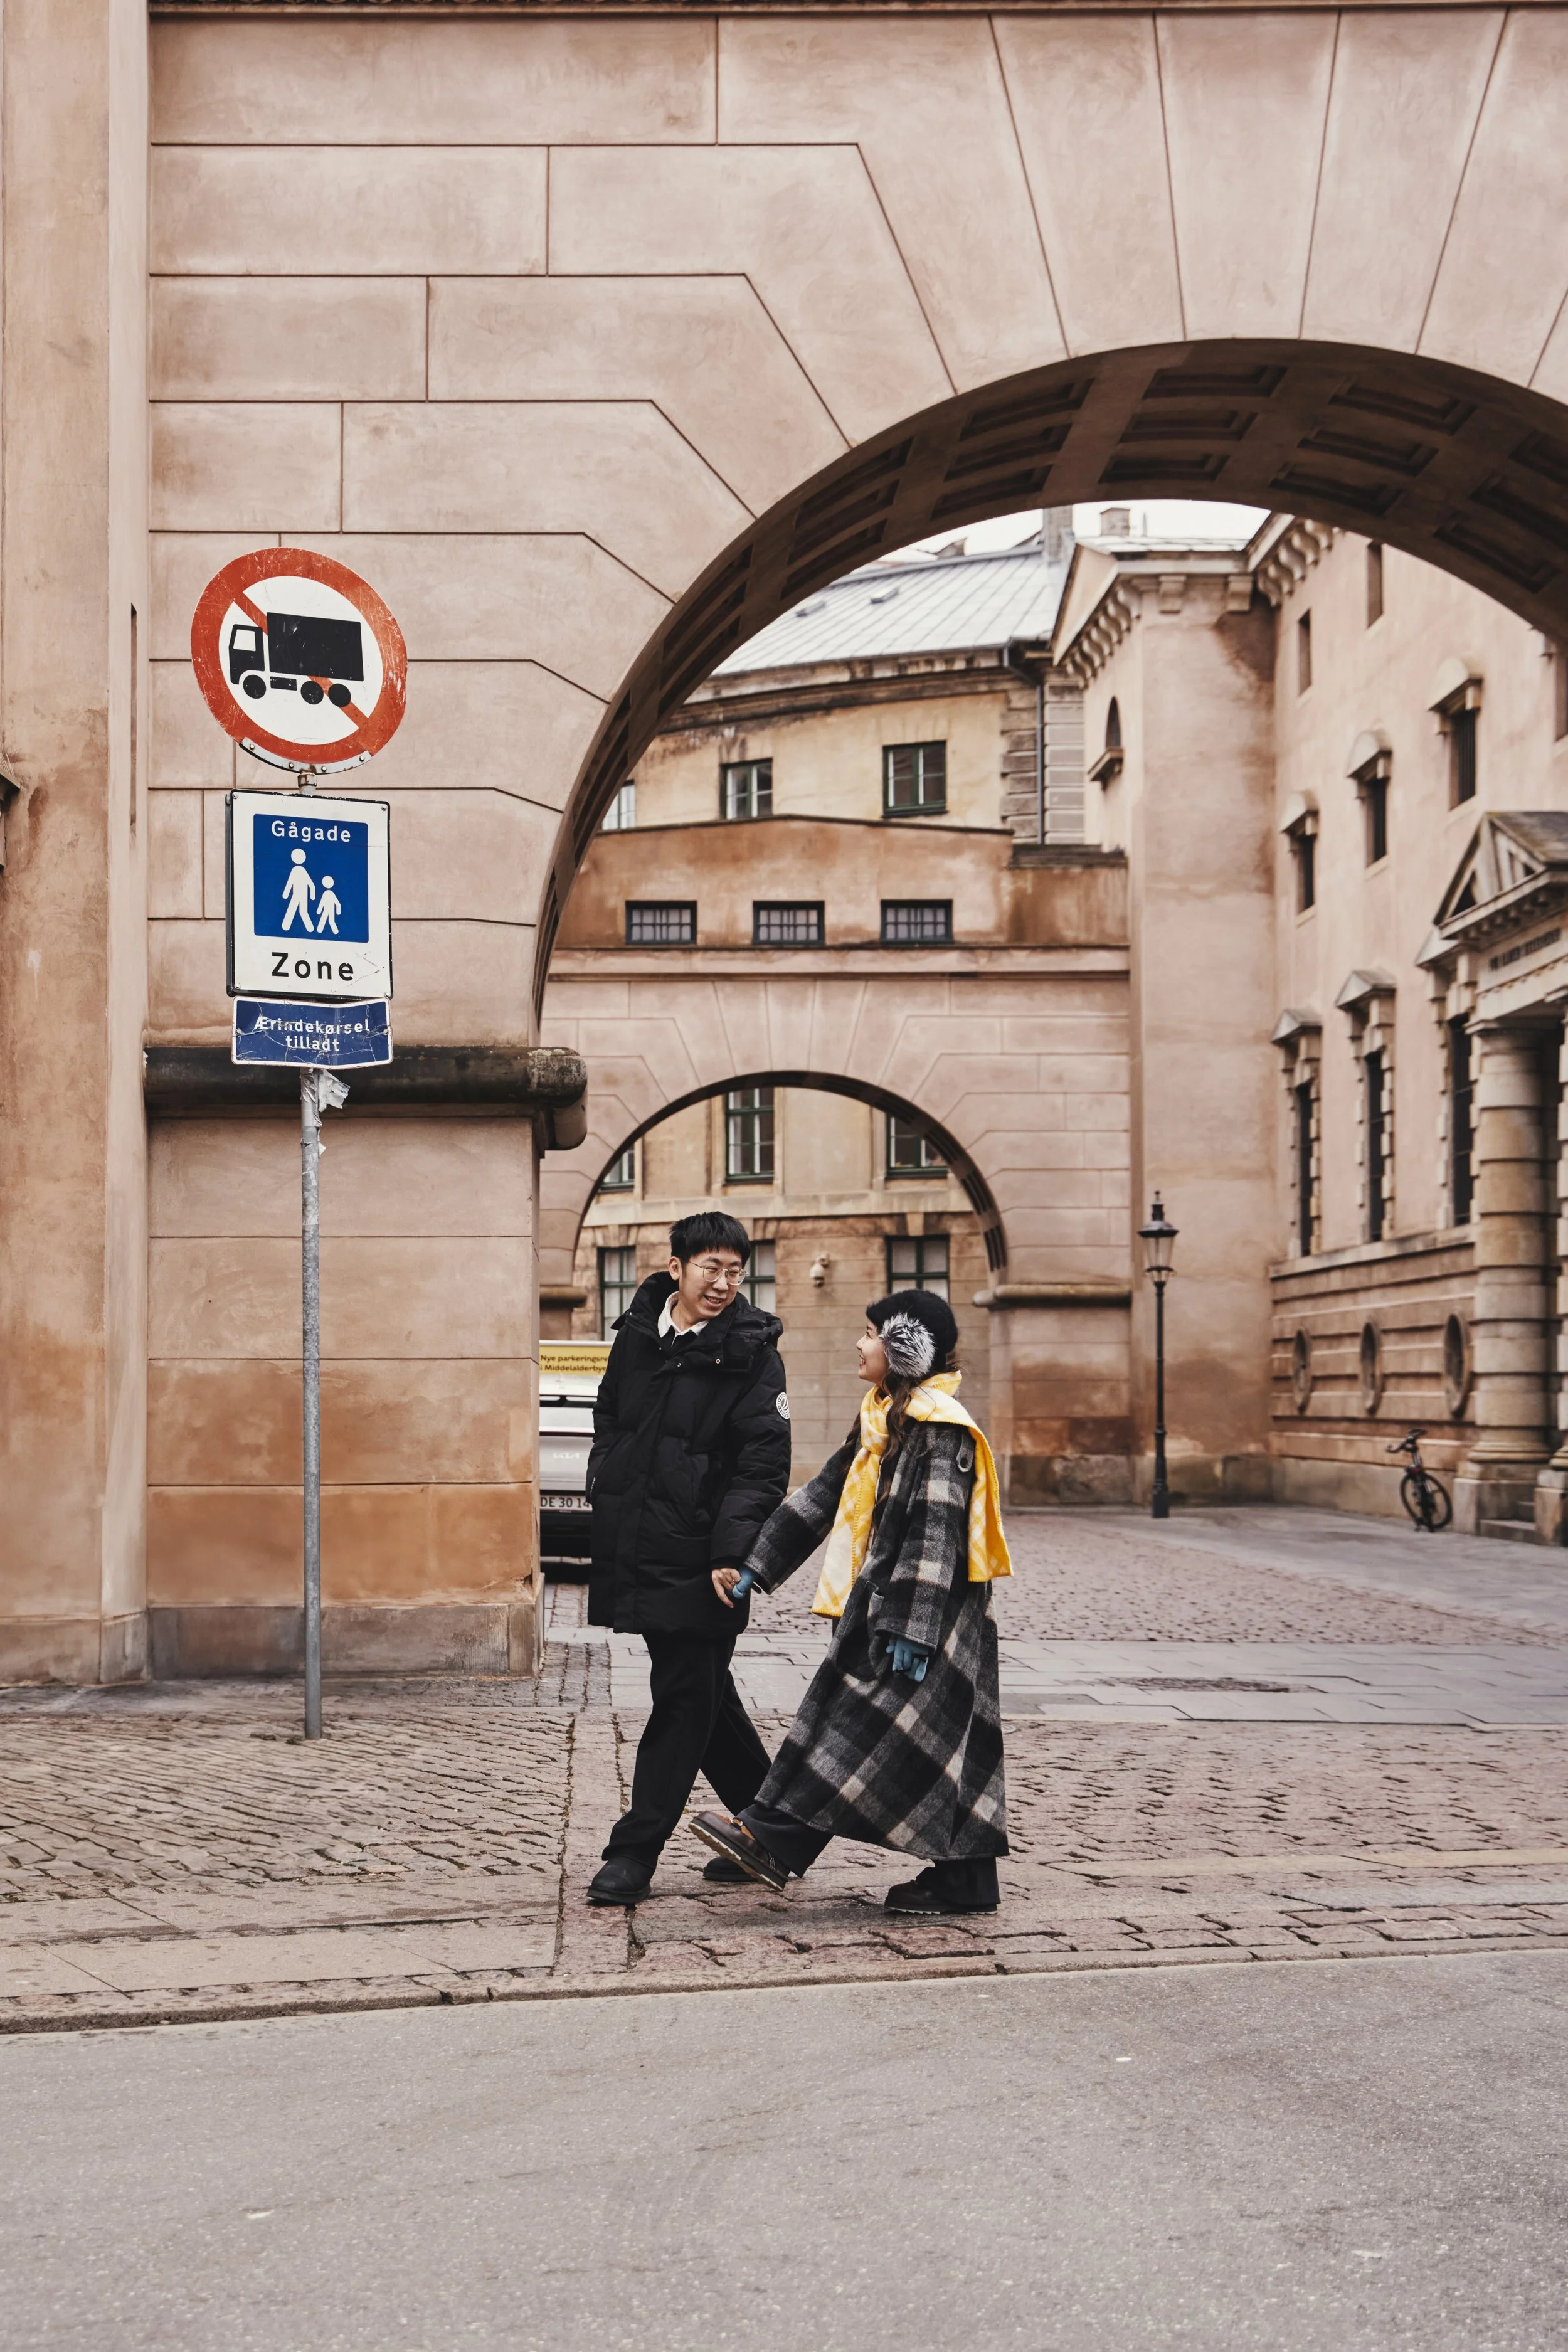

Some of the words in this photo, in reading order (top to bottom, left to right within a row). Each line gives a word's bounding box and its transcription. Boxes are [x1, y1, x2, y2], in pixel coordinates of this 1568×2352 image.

[271, 820, 351, 842] Gågade
[272, 952, 354, 981] Zone
[254, 1017, 370, 1035] Ærindekørsel
[285, 1035, 339, 1051] tilladt
[540, 1497, 555, 1507] DE
[559, 1497, 573, 1508] 30
